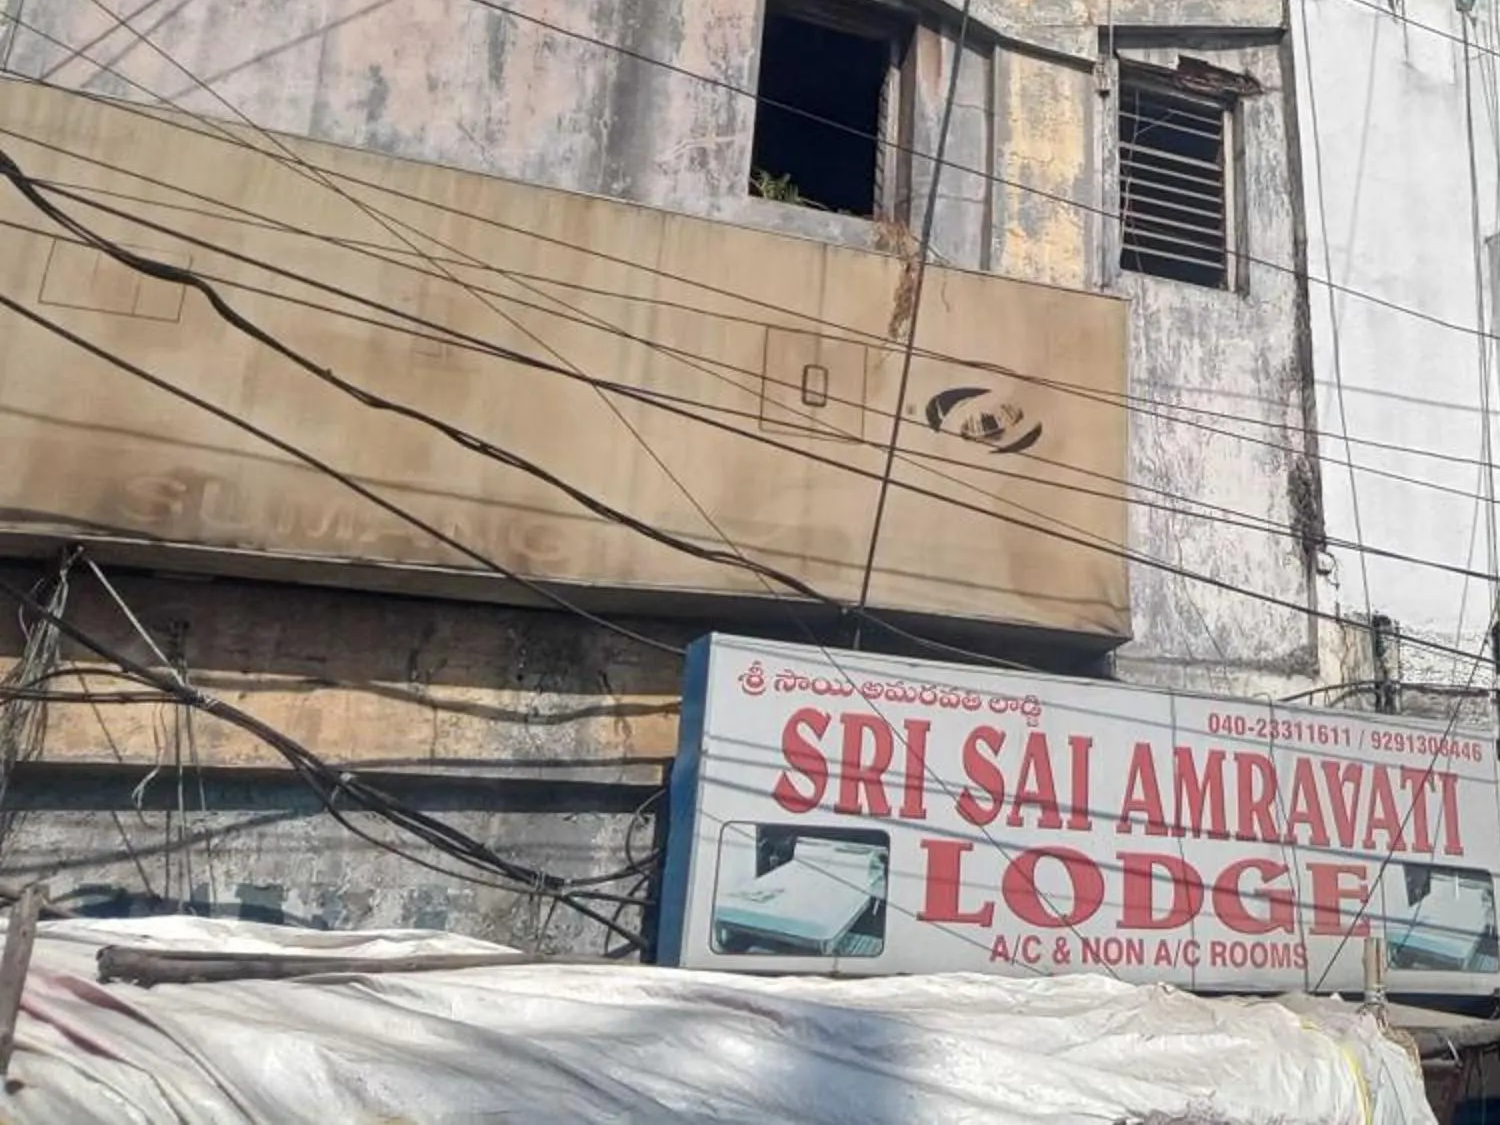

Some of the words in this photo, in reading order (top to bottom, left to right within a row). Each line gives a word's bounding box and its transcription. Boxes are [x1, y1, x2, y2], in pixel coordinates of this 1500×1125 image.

[775, 668, 854, 698] సాయి
[1208, 713, 1351, 747] 040-23311611
[771, 706, 932, 821] SRI
[955, 723, 1094, 832] SAI
[1116, 741, 1465, 857] AMRAVATI
[916, 837, 1372, 939] LODGE
[989, 934, 1043, 967] A/C
[1052, 938, 1073, 967] &
[1080, 936, 1147, 968] NON
[1154, 938, 1201, 969] A/C
[1209, 940, 1309, 971] ROOMS
